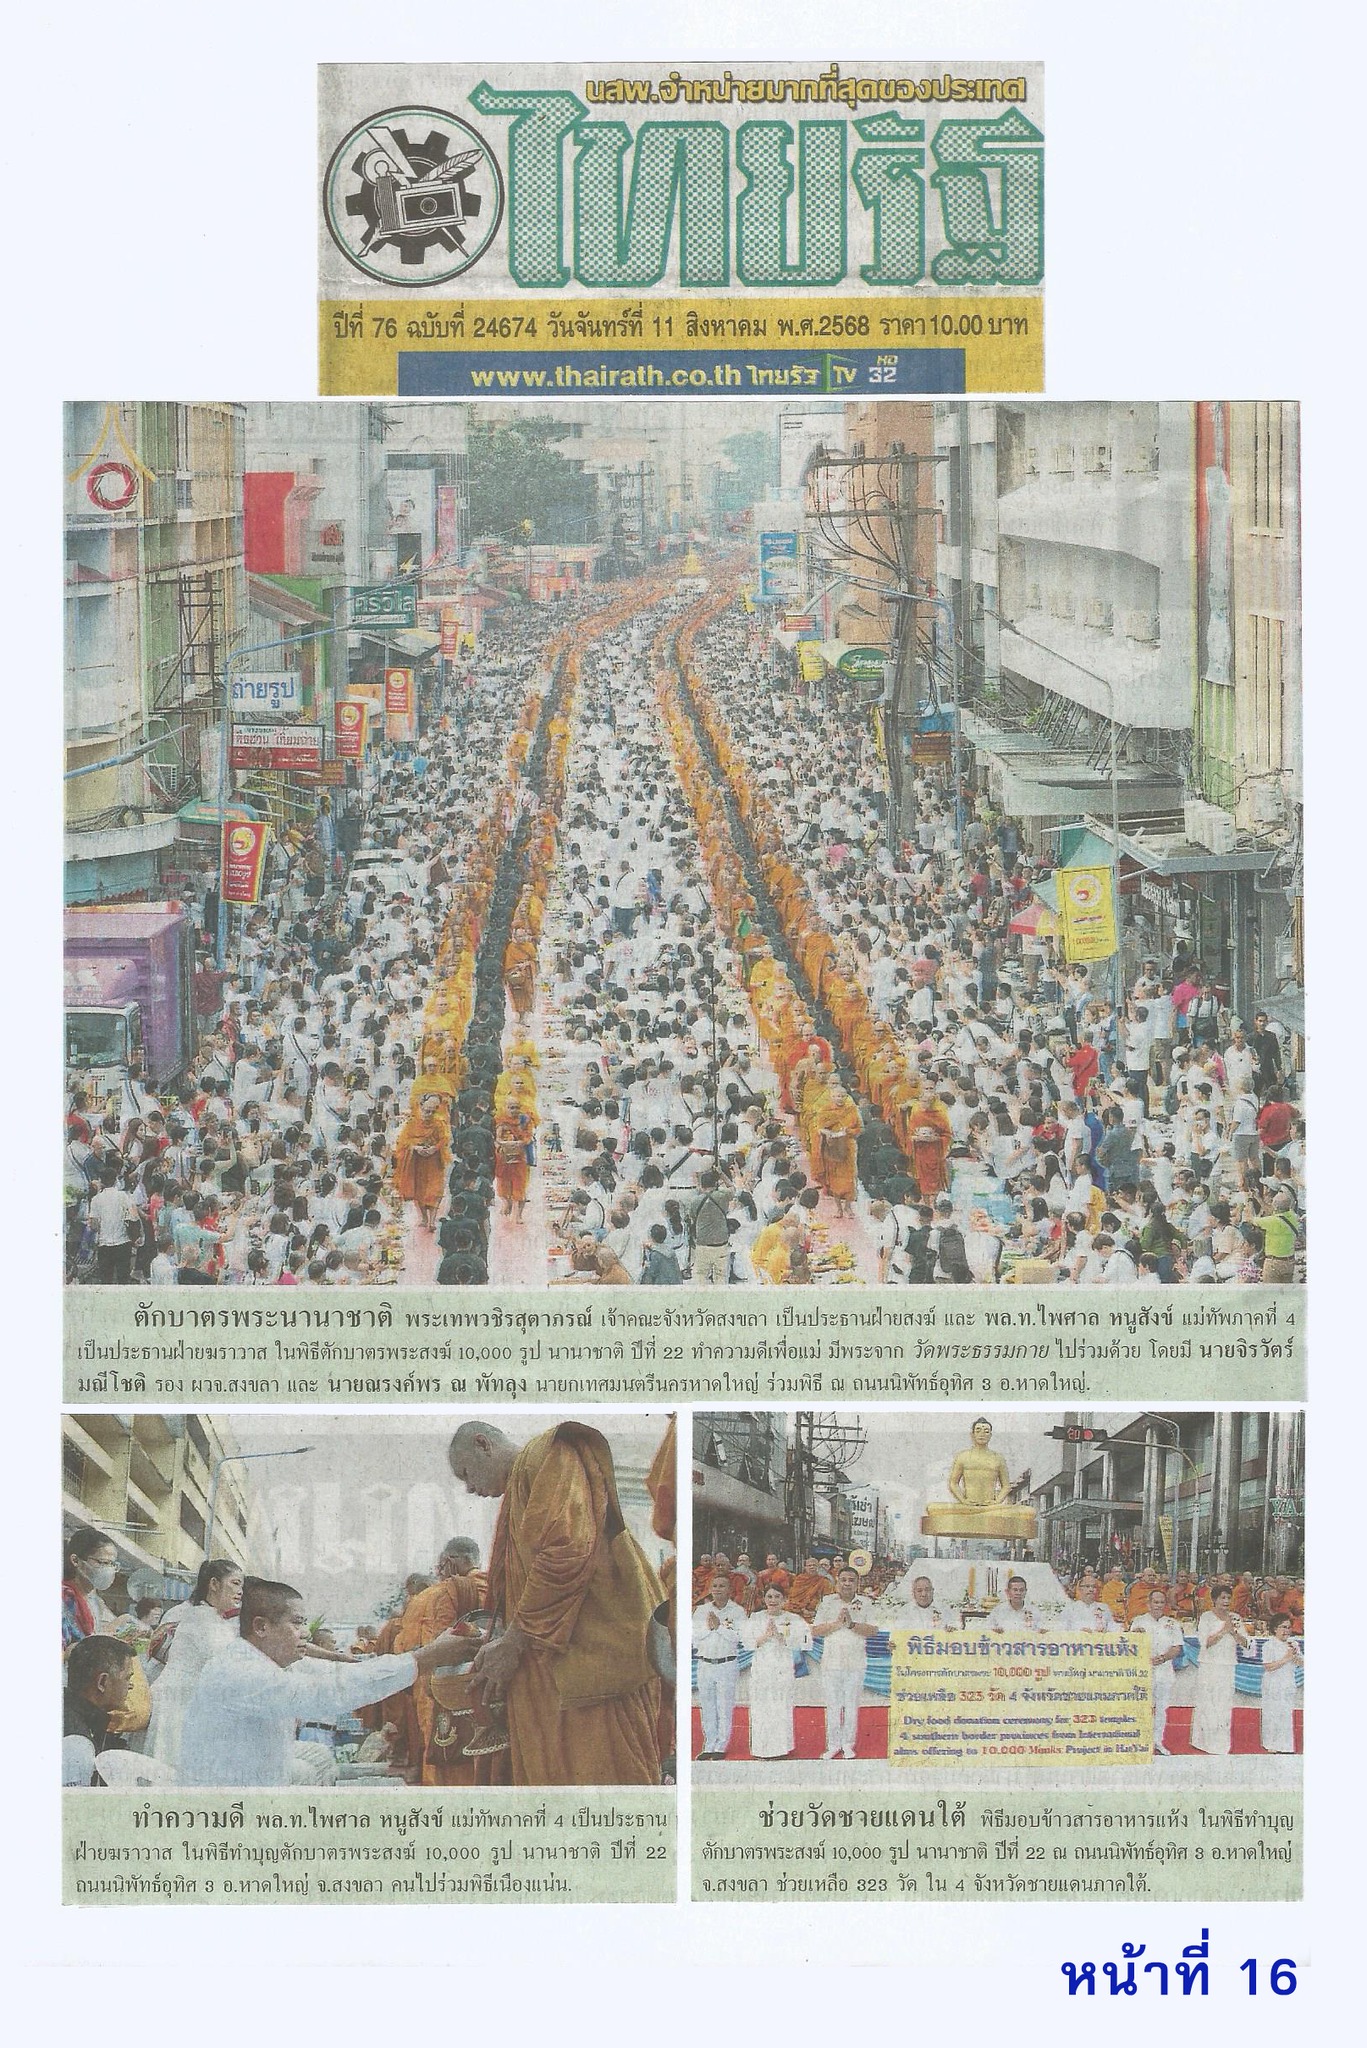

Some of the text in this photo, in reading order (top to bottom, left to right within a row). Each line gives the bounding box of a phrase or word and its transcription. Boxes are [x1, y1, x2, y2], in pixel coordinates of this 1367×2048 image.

[585, 62, 1027, 111] นสพ.จำหน่ายมากที่สุดของประเทศ
[470, 80, 1044, 288] ไทยรัฐ
[333, 303, 1029, 339] ปีที่ 76 ฉบับที่ 24674 วันจันทร์ที่ 11 สิงหาคม พ.ศ.2568 ราคา 10.00 บาท
[471, 364, 741, 388] www.thairath.co.th
[868, 366, 898, 384] 32
[232, 677, 295, 709] ถ่ายรูป
[134, 1301, 1296, 1335] ตักบาตรพระนานาชาติ พระเทพวชิรสุตาภรณ์ เจ้าคณะจังหวัดสงขลา เป็นประธานฝ่ายสงฆ์ และ พล.ท.ไพศาล หนูสังข์ แม่ทัพภาคที่ 4
[78, 1335, 1295, 1366] เป็นประธานฝ่ายฆราวาส ในพิธีตักบาตรพระสงฆ์ 10,000 รูป นานาชาติ ปีที่ 22 ทำความดีเพื่อแม่ มีพระจาก วัดพระธรรมกาย ไปร่วมด้วย โดยมี นายจิรวัตร์
[77, 1370, 1091, 1400] มณีโชติ รอง ผวจ.สงขลา และ นายณรงค์พร ณ พัทลุง นายกเทศมนตรีนครหาดใหญ่ ร่วมพิธี ณ ถนนนิพัทธ์อุทิศ 3 อ.หาดใหญ่.
[1269, 1497, 1305, 1518] YA
[907, 1634, 1139, 1658] พิธีมอบข้าวสารอาหารแห้ง
[903, 1715, 925, 1727] Dry
[927, 1715, 951, 1726] food
[953, 1715, 1000, 1726] donation
[961, 1731, 998, 1741] border
[132, 1801, 668, 1836] ทำความดี พล.ท.ไพศาล หนูสังข์ แม่ทัพภาคที่ 4 เป็นประธาน
[758, 1799, 1294, 1834] ช่วยวัดชายแดนใต้ พิธีมอบข้าวสารอาหารแห้ง ในพิธีทำบุญ
[75, 1839, 667, 1866] ฝ่ายฆราวาส ในพิธีทำบุญตักบาตรพระสงฆ์ 10,000 รูป นานาชาติ ปีที่ 22
[702, 1838, 1292, 1866] ตักบาตรพระสงฆ์ 10,000 รูป นานาชาติ ปีที่ 22 ณ ถนนนิพัทธ์อุทิศ 3 อ.หาดใหญ่
[76, 1871, 572, 1899] ถนนนิพัทธ์อุทิศ 3 อ.หาดใหญ่ จ.สงขลา คนไปร่วมพิธีเนืองแน่น.
[703, 1871, 1152, 1893] จ.สงขลา ช่วยเหลือ 323 วัด ใน 4 จังหวัดชายแดนภาคใต้.
